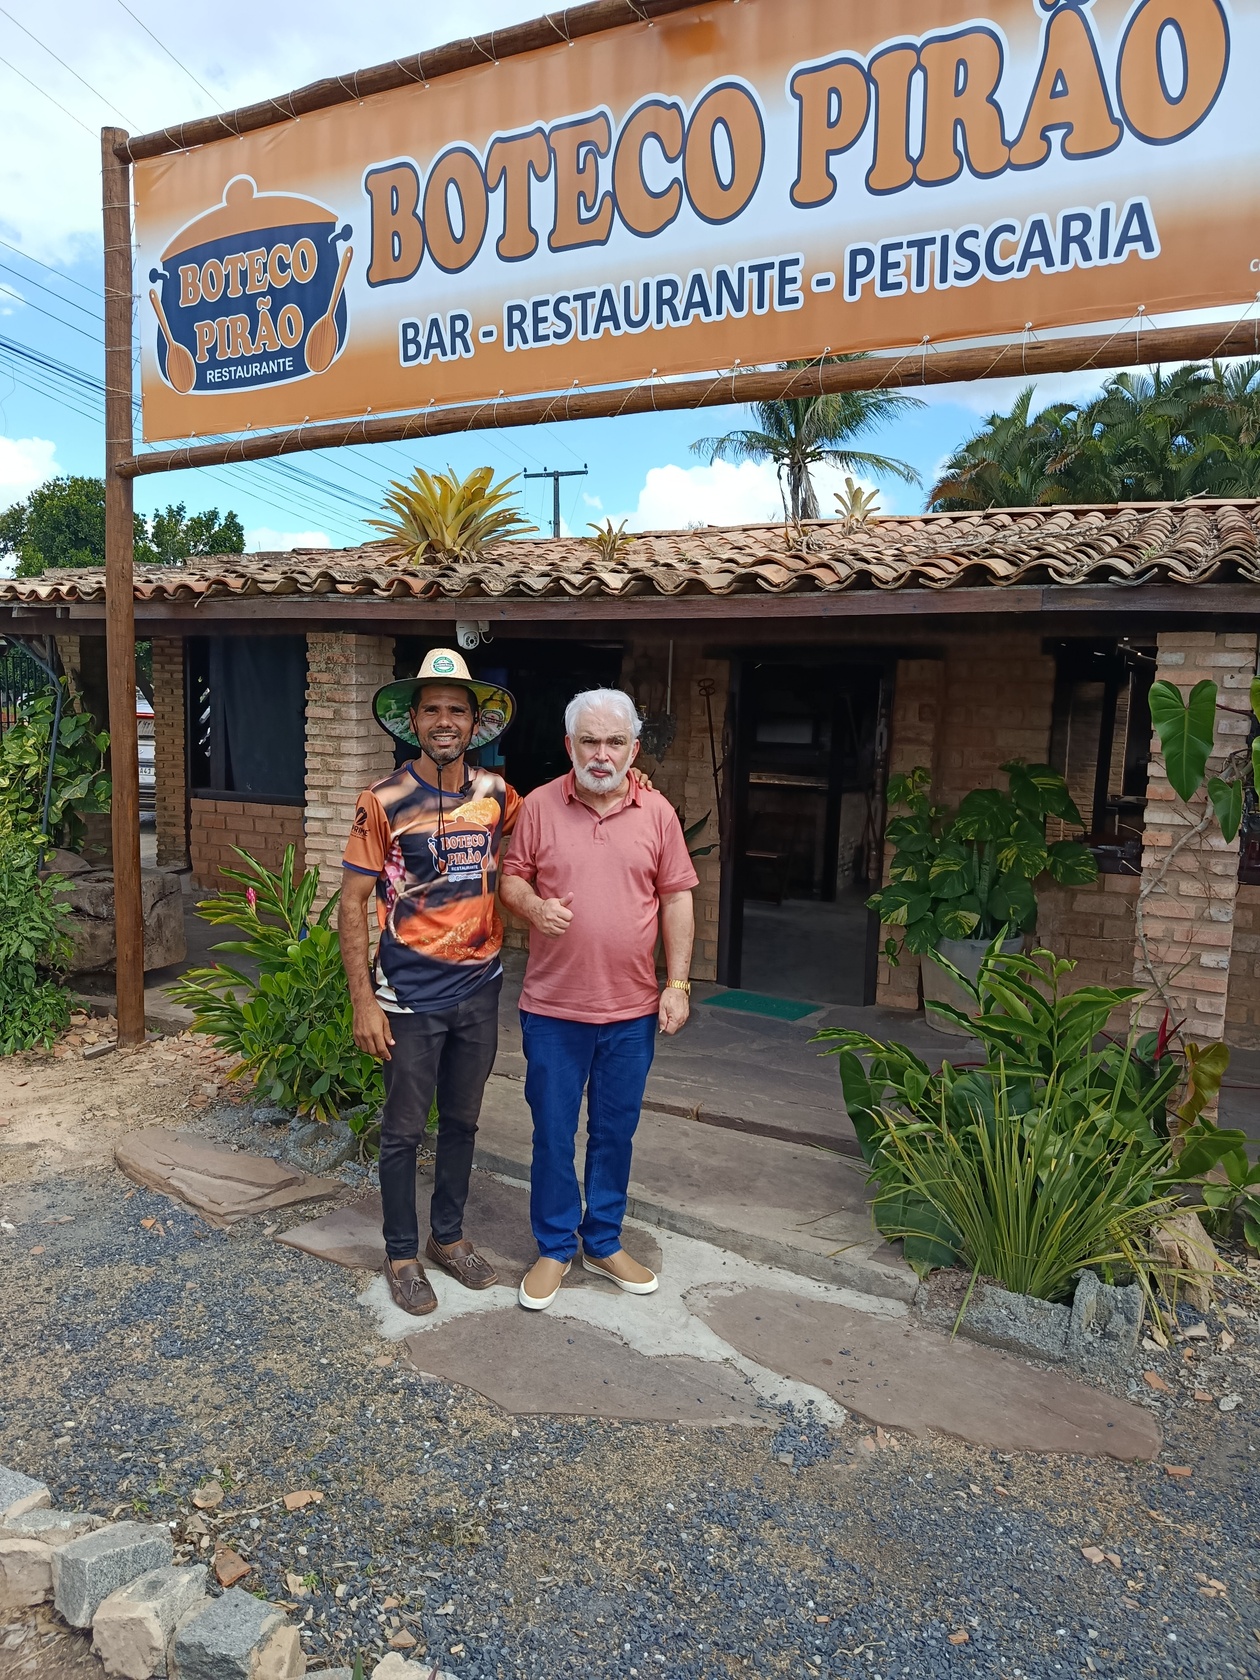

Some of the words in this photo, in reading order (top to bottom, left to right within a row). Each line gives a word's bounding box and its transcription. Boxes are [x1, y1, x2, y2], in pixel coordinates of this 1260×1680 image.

[365, 82, 765, 287] BOTECO
[790, 0, 1231, 208] PIRÃO
[179, 238, 318, 307] BOTECO
[402, 313, 471, 363] BAR
[506, 257, 801, 348] RESTAURANTE
[815, 278, 831, 287] -
[848, 202, 1155, 296] PETISCARIA
[194, 296, 304, 363] PIRÃO
[207, 357, 294, 383] RESTAURANTE
[440, 834, 485, 850] BOTECO
[447, 848, 481, 866] PIRÃO
